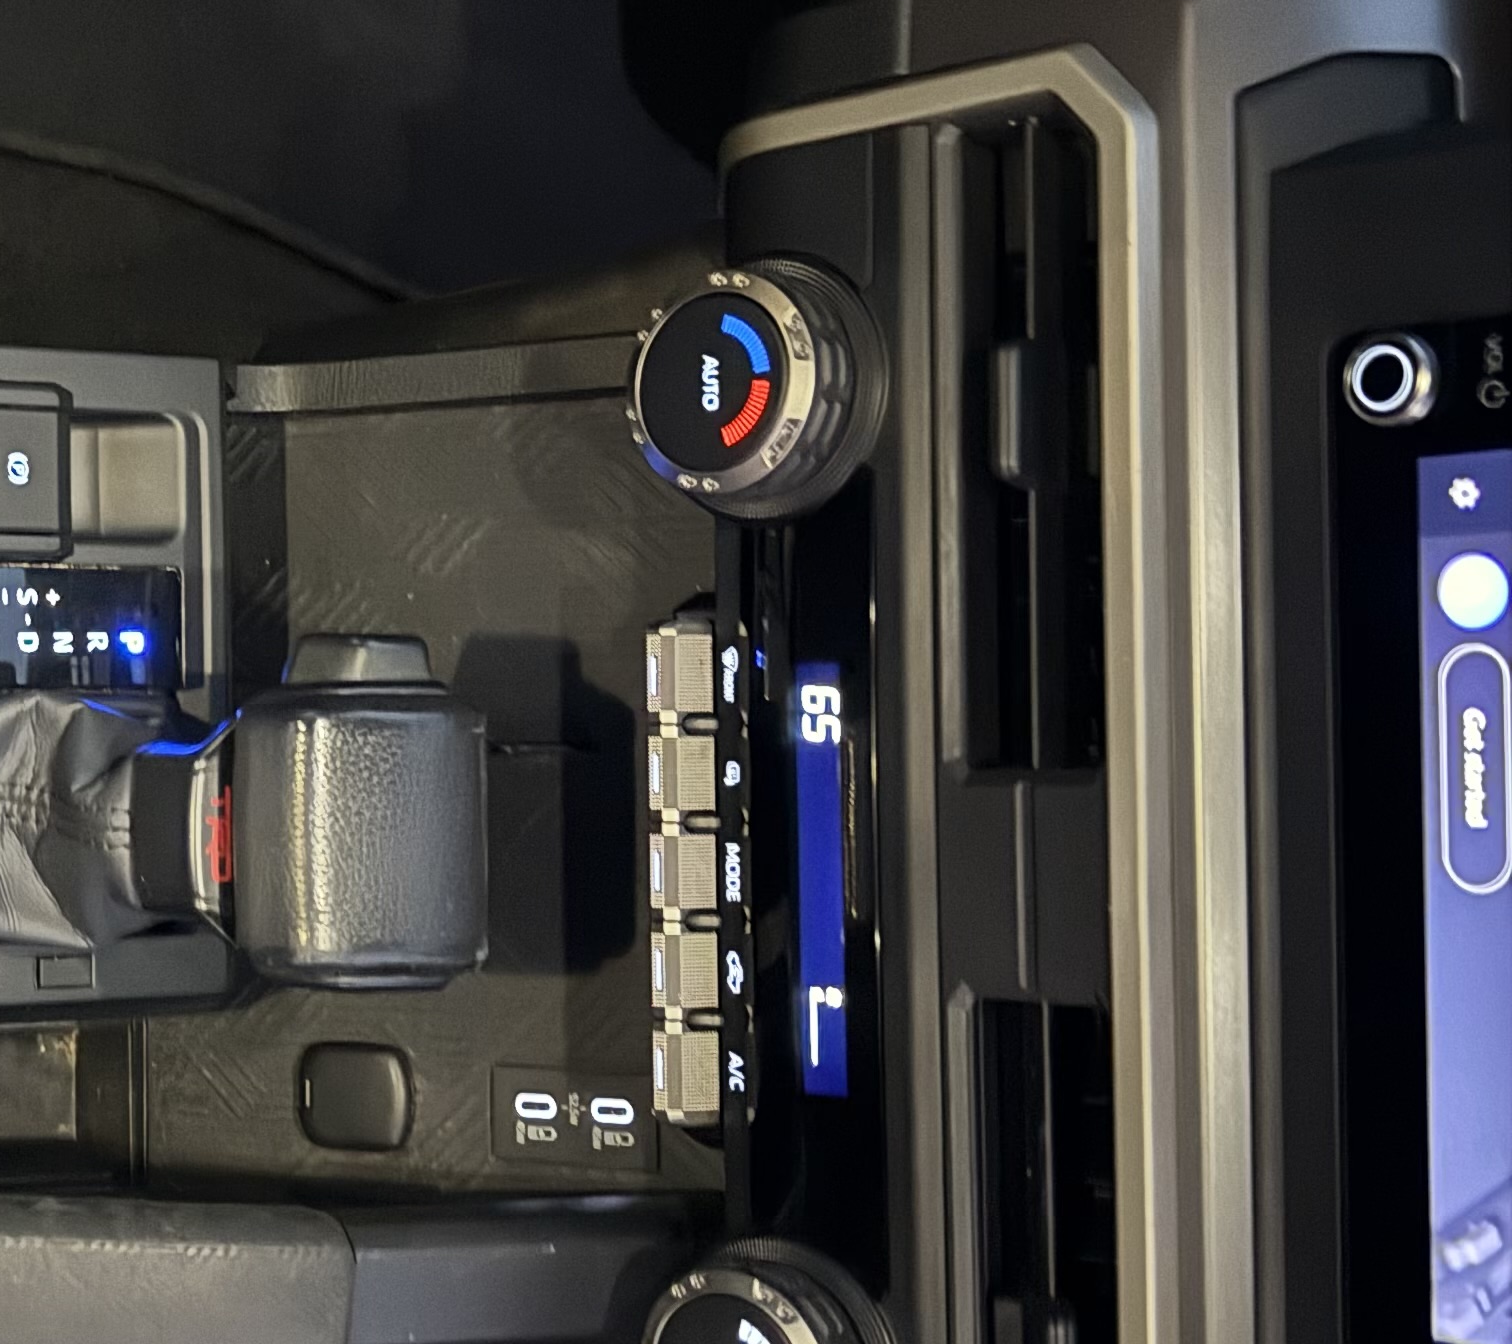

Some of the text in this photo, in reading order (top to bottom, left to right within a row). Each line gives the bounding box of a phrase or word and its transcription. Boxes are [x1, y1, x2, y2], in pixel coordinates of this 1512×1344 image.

[701, 354, 720, 412] AUTO
[17, 631, 39, 653] D
[52, 631, 74, 653] N
[86, 630, 109, 652] R
[119, 630, 145, 654] P
[800, 684, 842, 746] 65
[1462, 707, 1487, 752] Get
[205, 784, 232, 883] TRD
[725, 842, 741, 903] MODE
[728, 1050, 745, 1093] A/C
